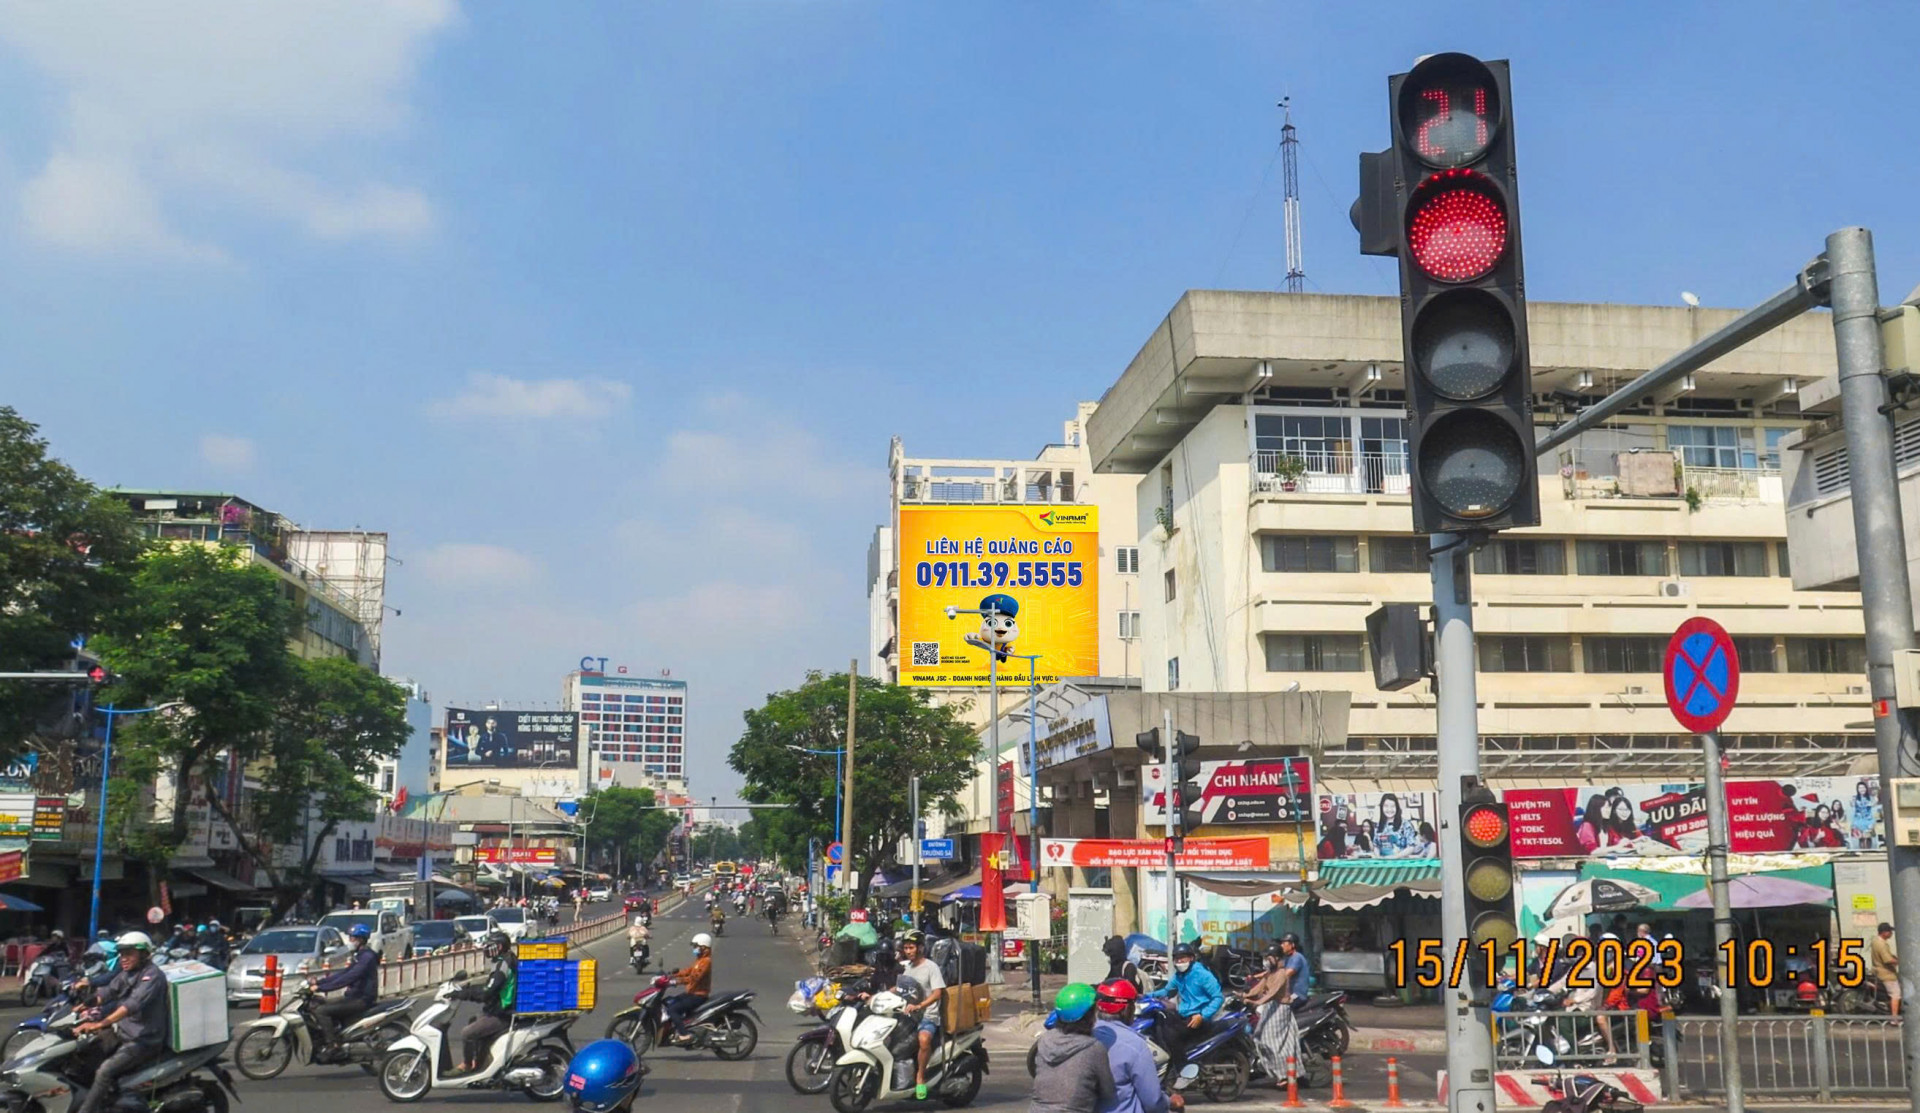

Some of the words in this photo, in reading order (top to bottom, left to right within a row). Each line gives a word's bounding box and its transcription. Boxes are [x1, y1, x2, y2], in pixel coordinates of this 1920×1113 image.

[1418, 88, 1488, 156] 21
[926, 538, 959, 555] LIÊN
[964, 537, 983, 558] HỆ
[988, 537, 1038, 555] QUẢNG
[1044, 537, 1073, 555] CÁO
[916, 561, 1083, 587] 0911.39.5555
[580, 656, 609, 672] CT
[974, 674, 991, 683] NGHIỆ
[996, 674, 1013, 682] HÀNG
[1214, 774, 1236, 787] CHI
[1510, 800, 1537, 810] LUYỆN
[1537, 800, 1551, 809] THI
[1731, 798, 1742, 806] UY
[1744, 796, 1758, 805] TÍN
[1651, 805, 1675, 824] ƯU
[1679, 796, 1707, 817] ĐÃI
[1520, 813, 1542, 821] IELTS
[1733, 812, 1755, 821] CHẤT
[1756, 812, 1785, 823] LƯỢNG
[1521, 825, 1545, 833] TOEIC
[1664, 826, 1676, 836] UP
[1677, 823, 1688, 833] TO
[1689, 818, 1708, 830] 300
[1735, 829, 1755, 840] HIỆU
[1756, 828, 1775, 838] QUẢ
[1521, 837, 1564, 845] TKT-TESOL
